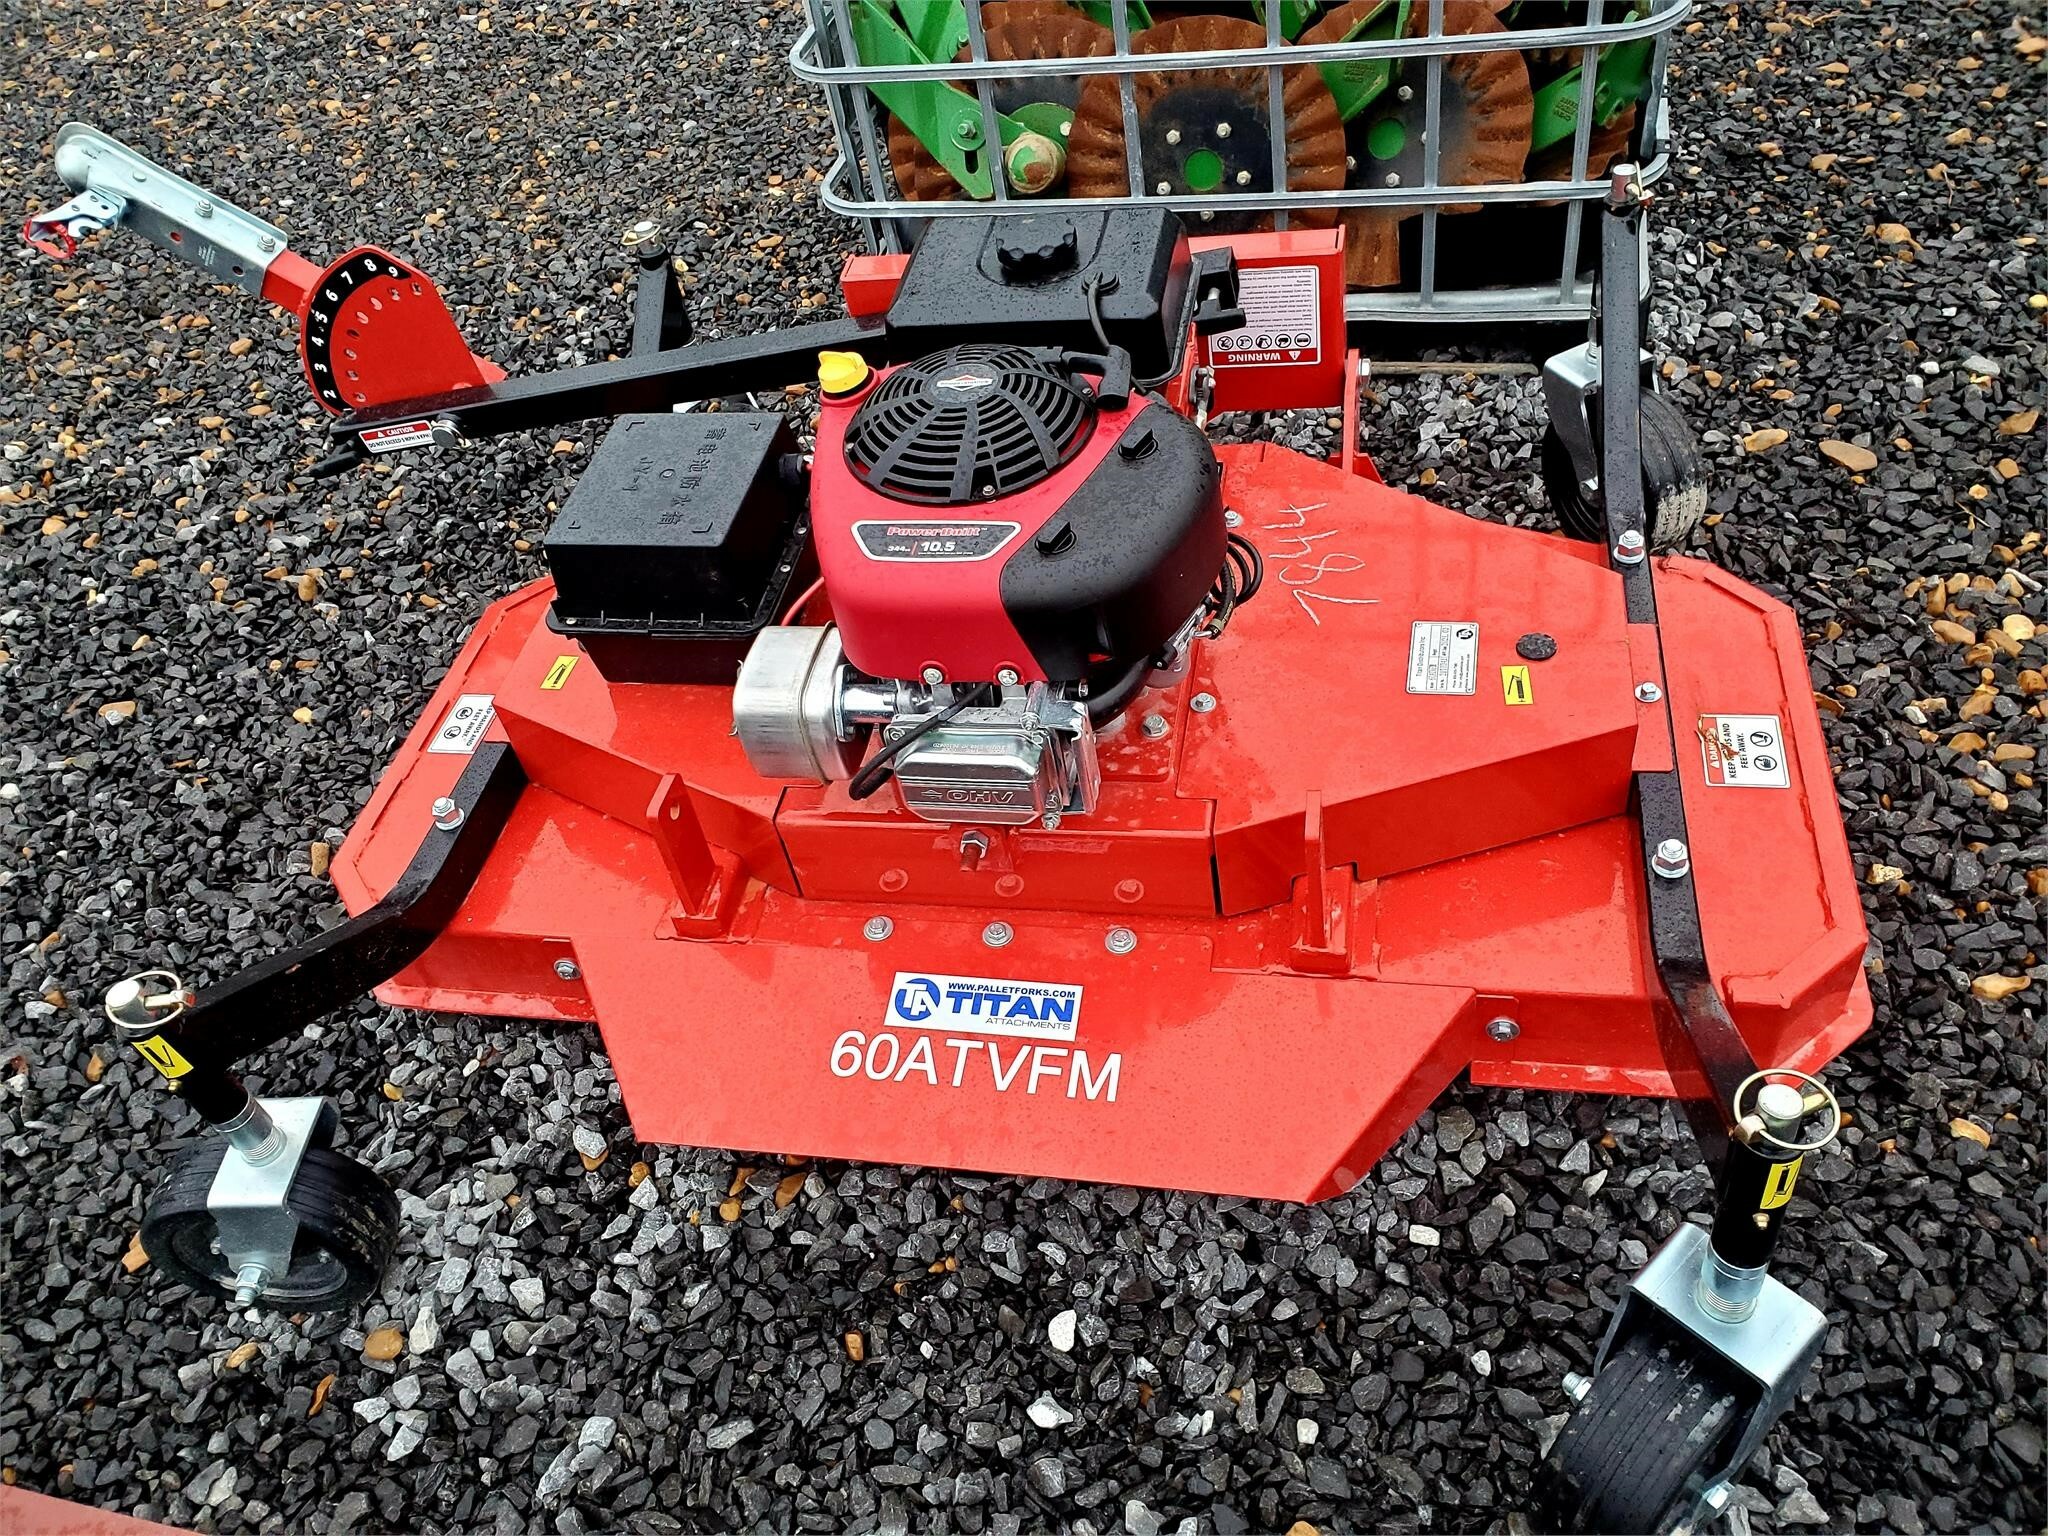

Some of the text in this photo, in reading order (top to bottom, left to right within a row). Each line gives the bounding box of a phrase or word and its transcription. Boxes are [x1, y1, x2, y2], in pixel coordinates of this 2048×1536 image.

[364, 259, 377, 272] 8
[388, 266, 399, 278] 9
[340, 270, 353, 285] 7
[325, 289, 339, 302] 6
[314, 310, 328, 324] 5
[311, 336, 325, 347] 4
[1228, 352, 1281, 363] WARNING
[314, 363, 328, 373] 3
[323, 389, 337, 399] 2
[386, 426, 415, 436] CAUTION
[921, 541, 956, 552] 10.5
[1722, 723, 1732, 737] AND
[1727, 761, 1737, 778] KEEP
[946, 789, 1015, 804] OHV
[948, 982, 1076, 999] WWW.PALLETFORKS.COM
[946, 990, 1076, 1023] TITAN
[985, 1017, 1071, 1031] ATTACHMENTS
[829, 1030, 1122, 1103] 60ATVFM
